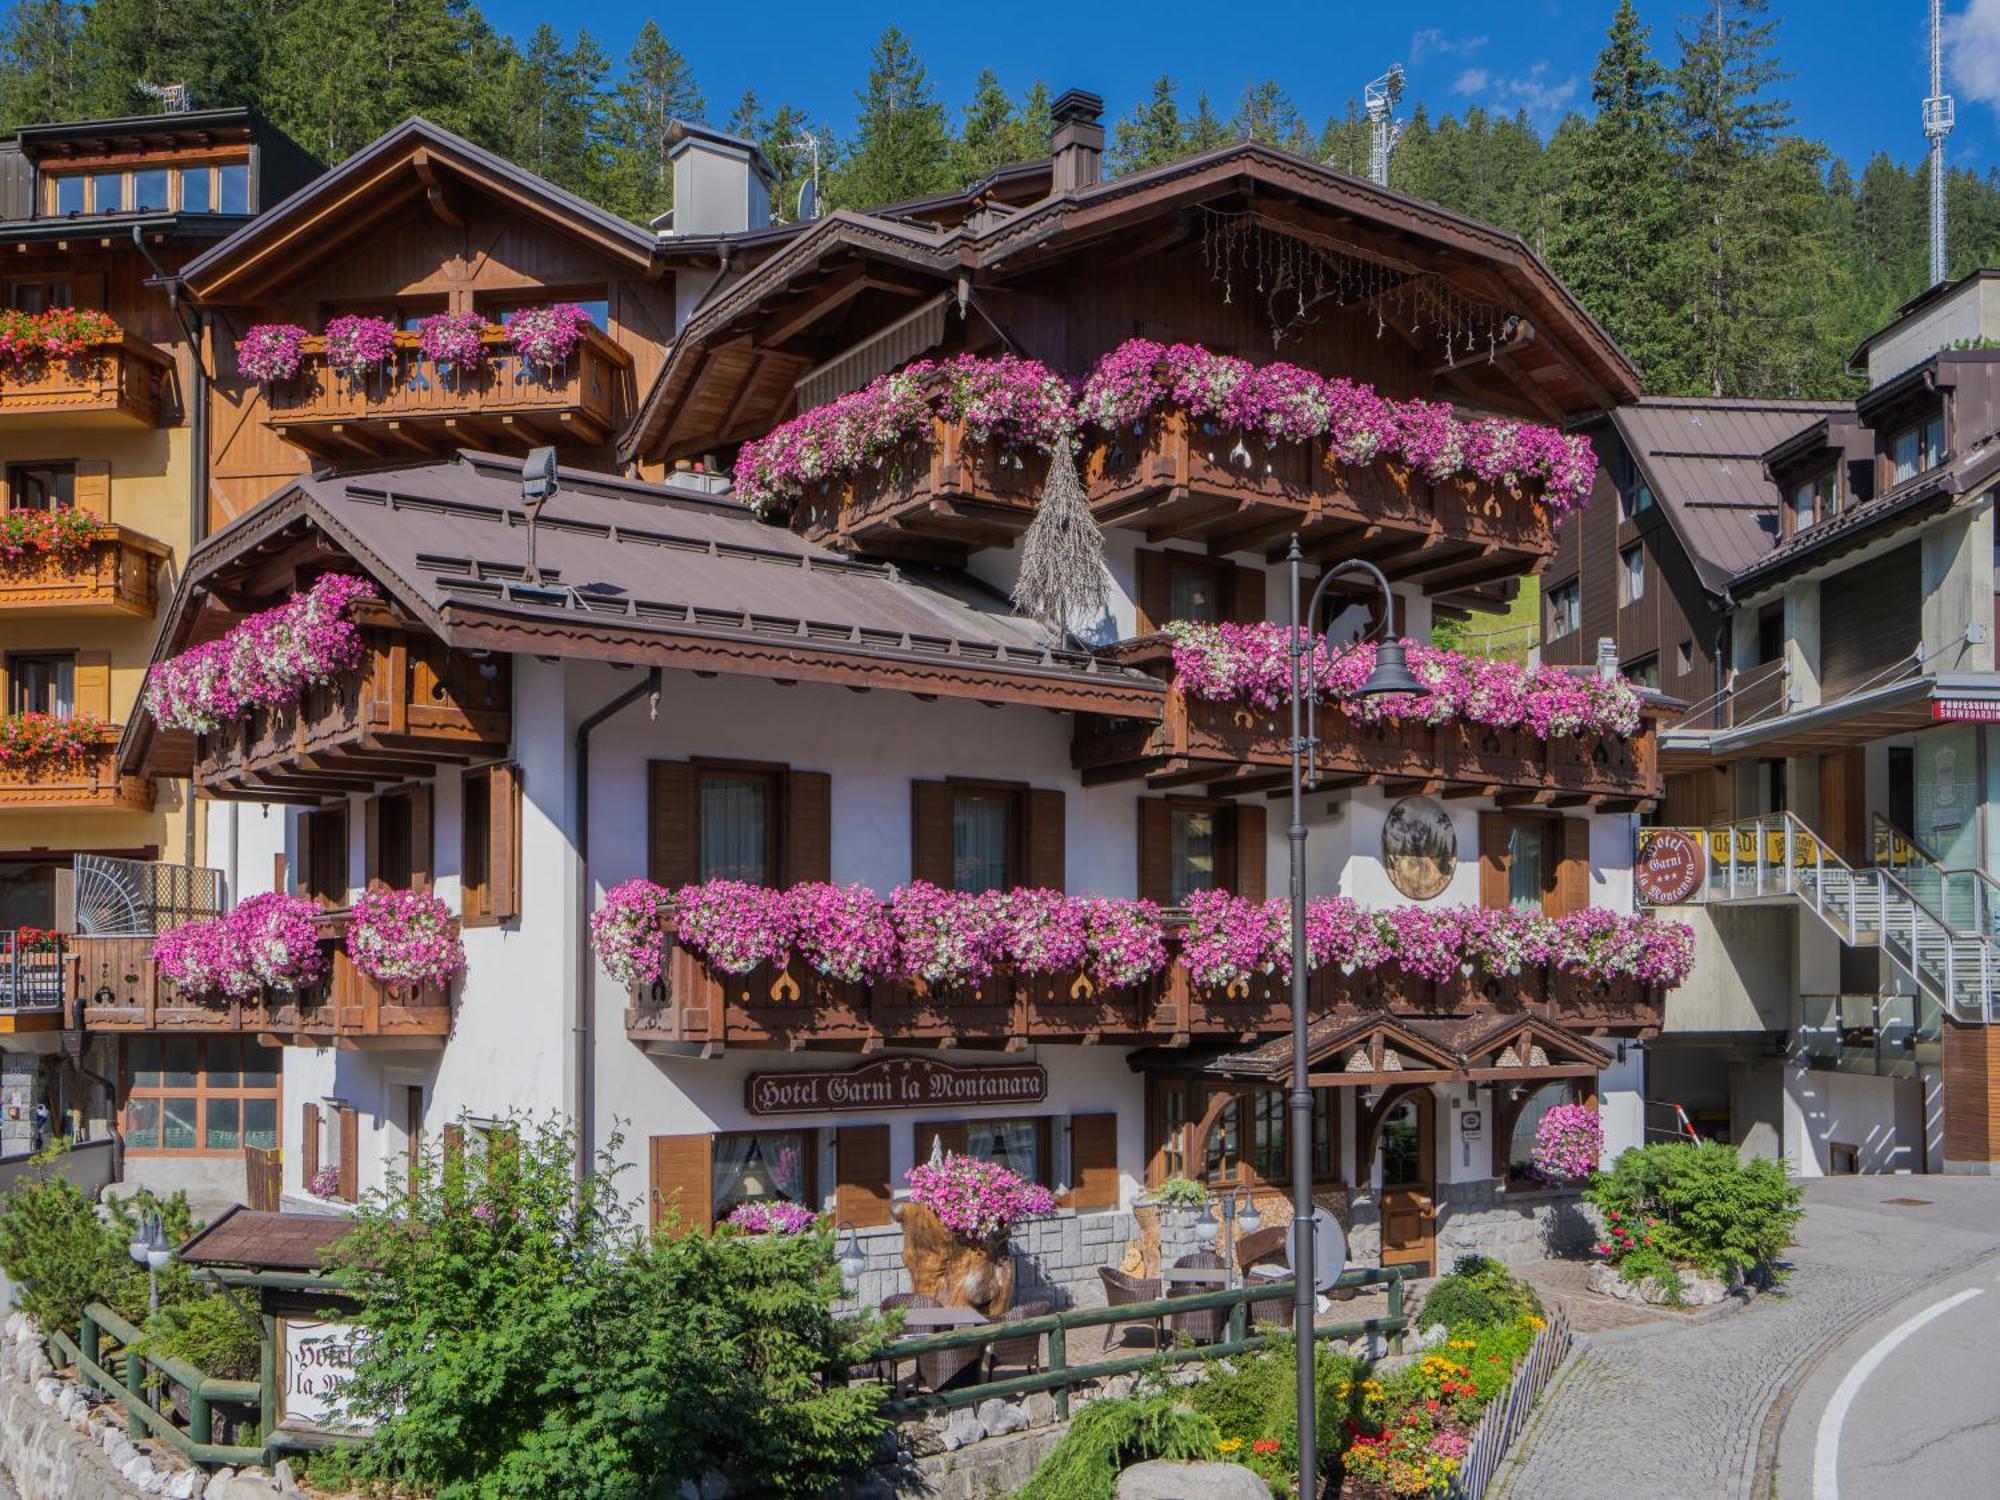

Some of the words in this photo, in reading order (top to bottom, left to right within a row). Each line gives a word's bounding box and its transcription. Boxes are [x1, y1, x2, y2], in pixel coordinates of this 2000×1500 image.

[759, 1078, 819, 1109] Hotel
[901, 1074, 920, 1099] la
[930, 1073, 1040, 1098] Montanara
[297, 1372, 313, 1395] la
